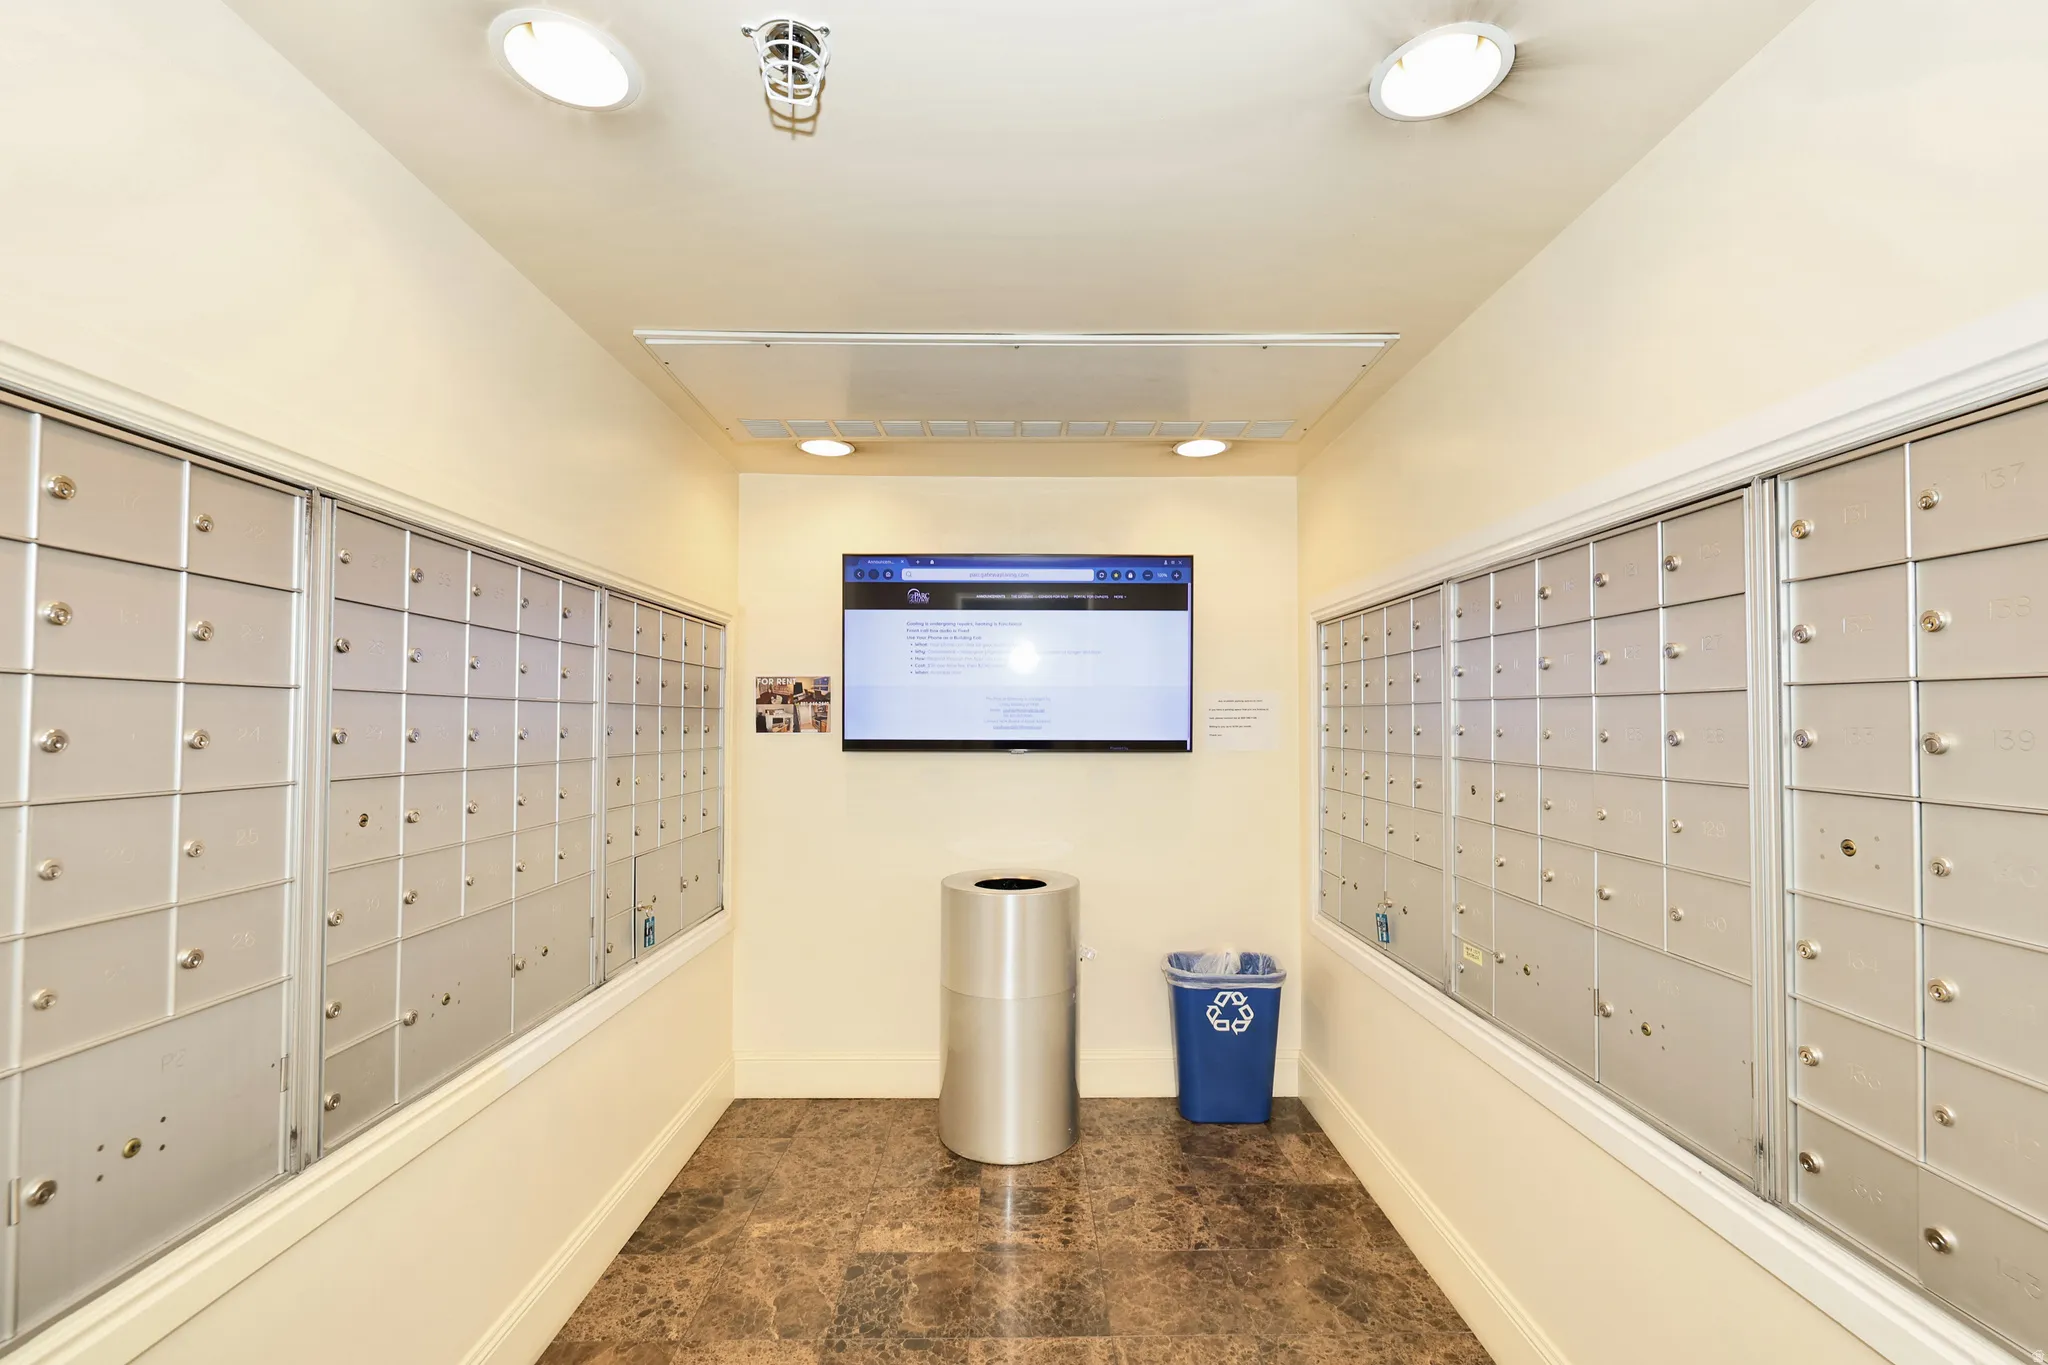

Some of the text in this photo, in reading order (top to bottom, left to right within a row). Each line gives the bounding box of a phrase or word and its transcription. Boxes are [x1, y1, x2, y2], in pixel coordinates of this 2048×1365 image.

[1981, 459, 2026, 491] 137
[1842, 501, 1868, 525] 131
[1988, 595, 2033, 621] 138
[1841, 616, 1873, 635] 132
[1701, 633, 1723, 652] 127
[757, 678, 796, 686] FOR RENT
[237, 726, 264, 744] 24
[1842, 726, 1876, 746] 133
[1992, 728, 2037, 752] 139
[1622, 808, 1643, 824] 124
[235, 827, 260, 847] 25
[1701, 820, 1728, 839] 129
[232, 931, 258, 950] 26
